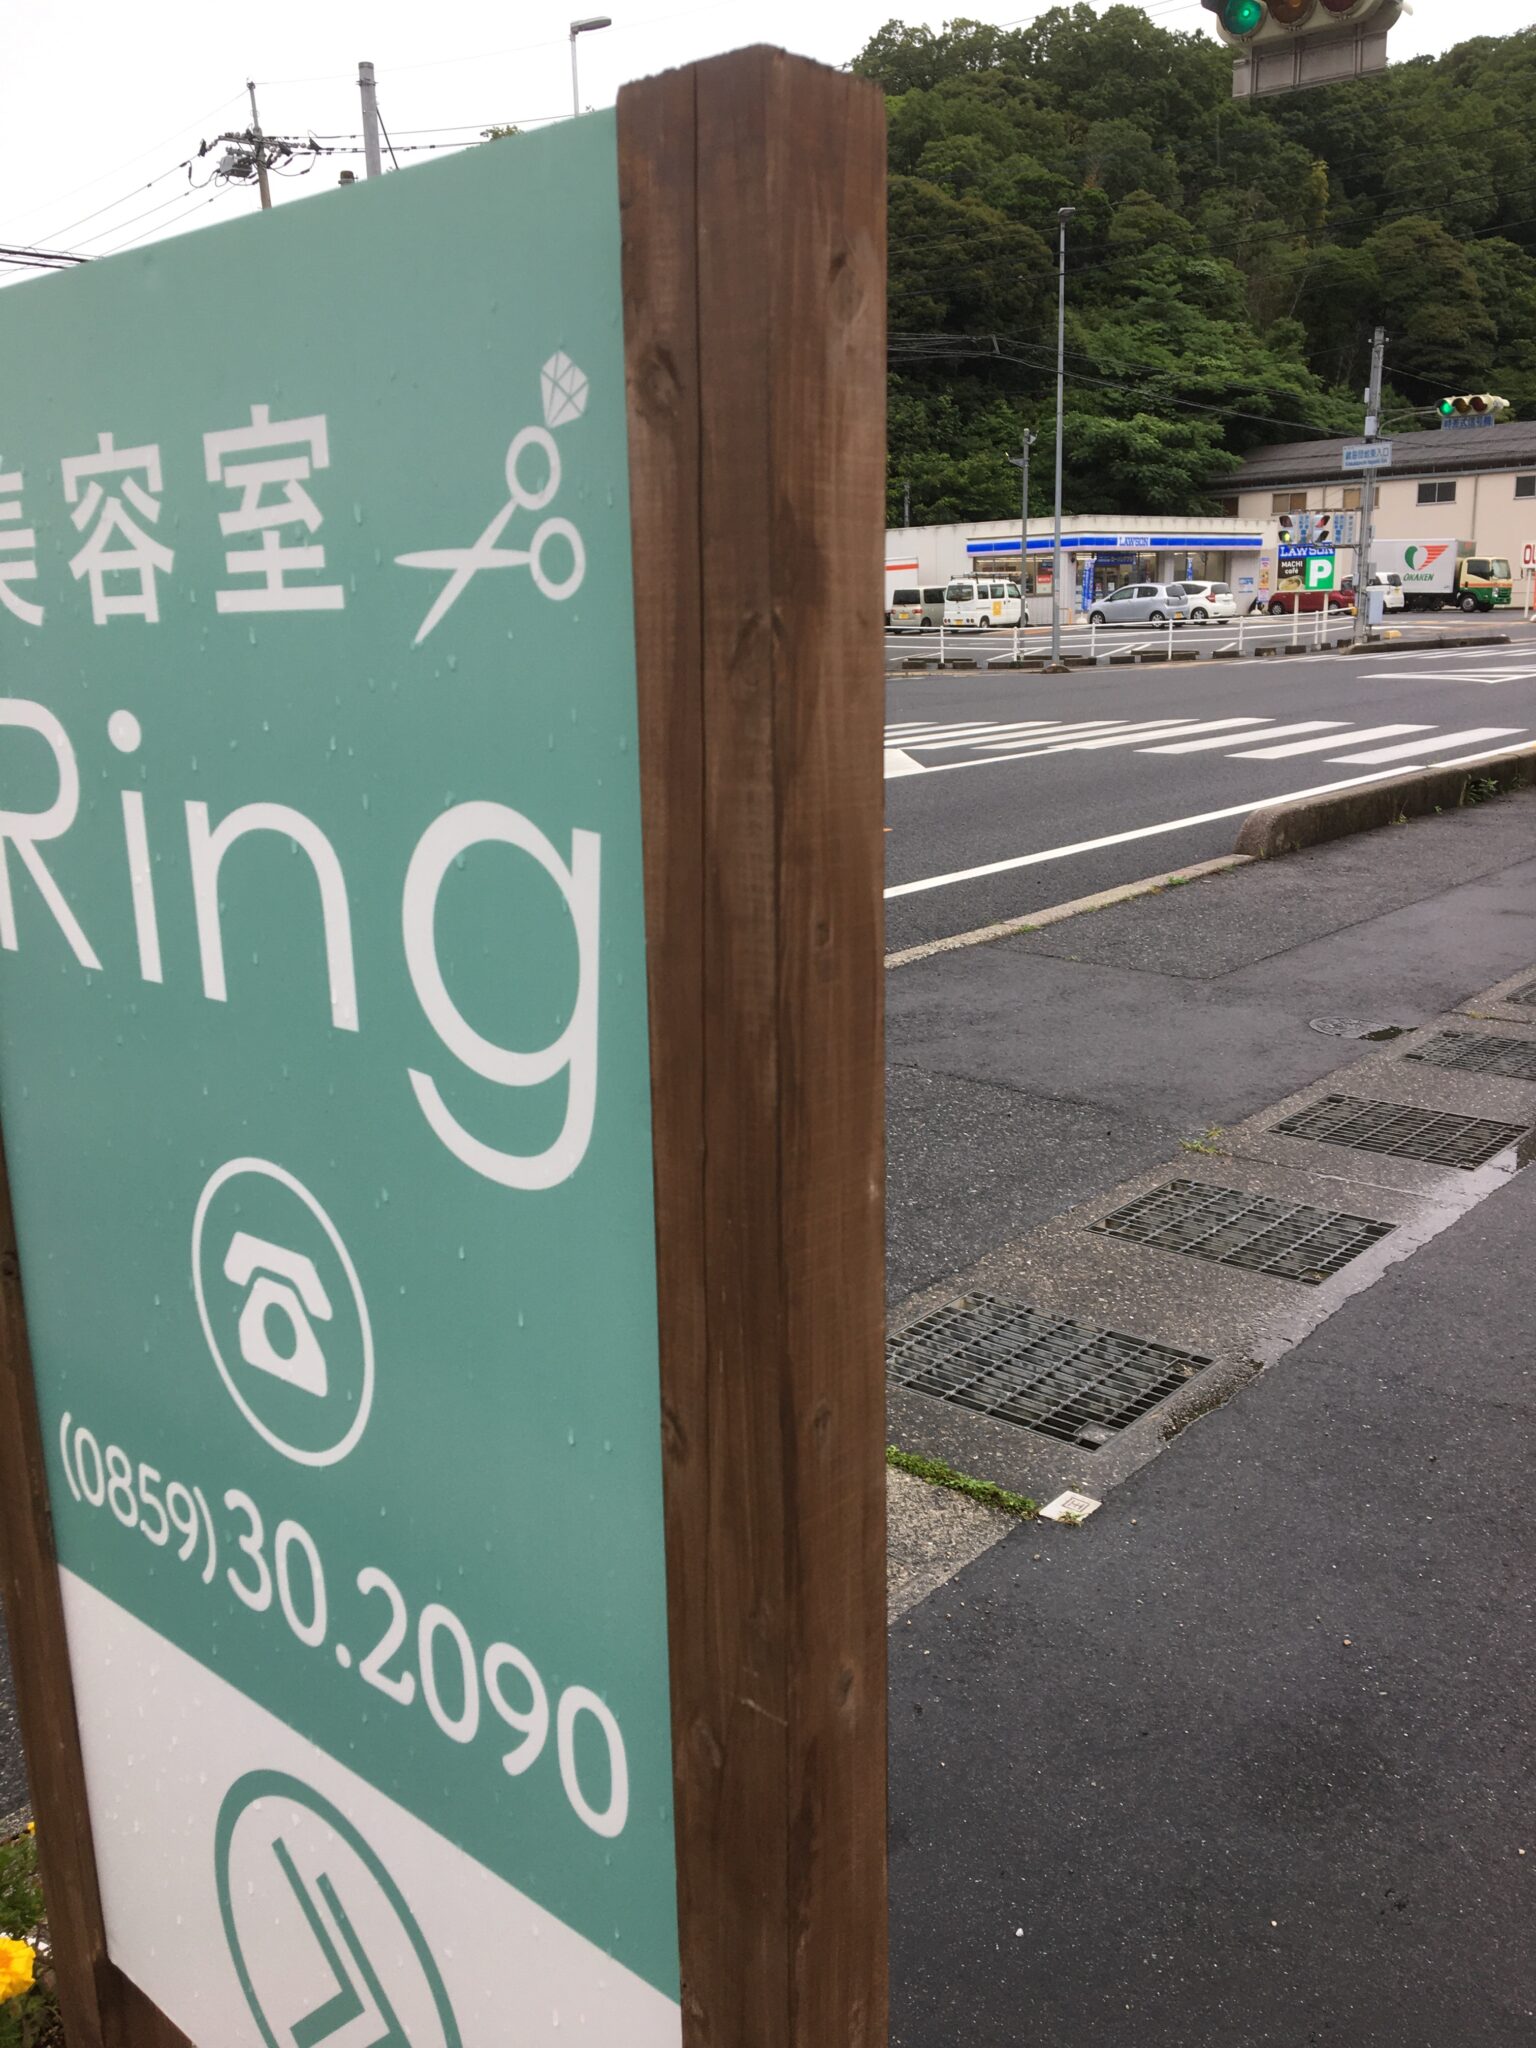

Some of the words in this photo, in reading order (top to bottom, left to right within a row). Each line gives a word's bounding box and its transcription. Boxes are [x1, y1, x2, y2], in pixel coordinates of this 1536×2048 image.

[1119, 536, 1149, 547] LAWSON
[1281, 560, 1303, 568] MACHI
[1309, 559, 1332, 587] P
[1403, 573, 1434, 582] OKAKEN
[0, 697, 602, 1191] Ring
